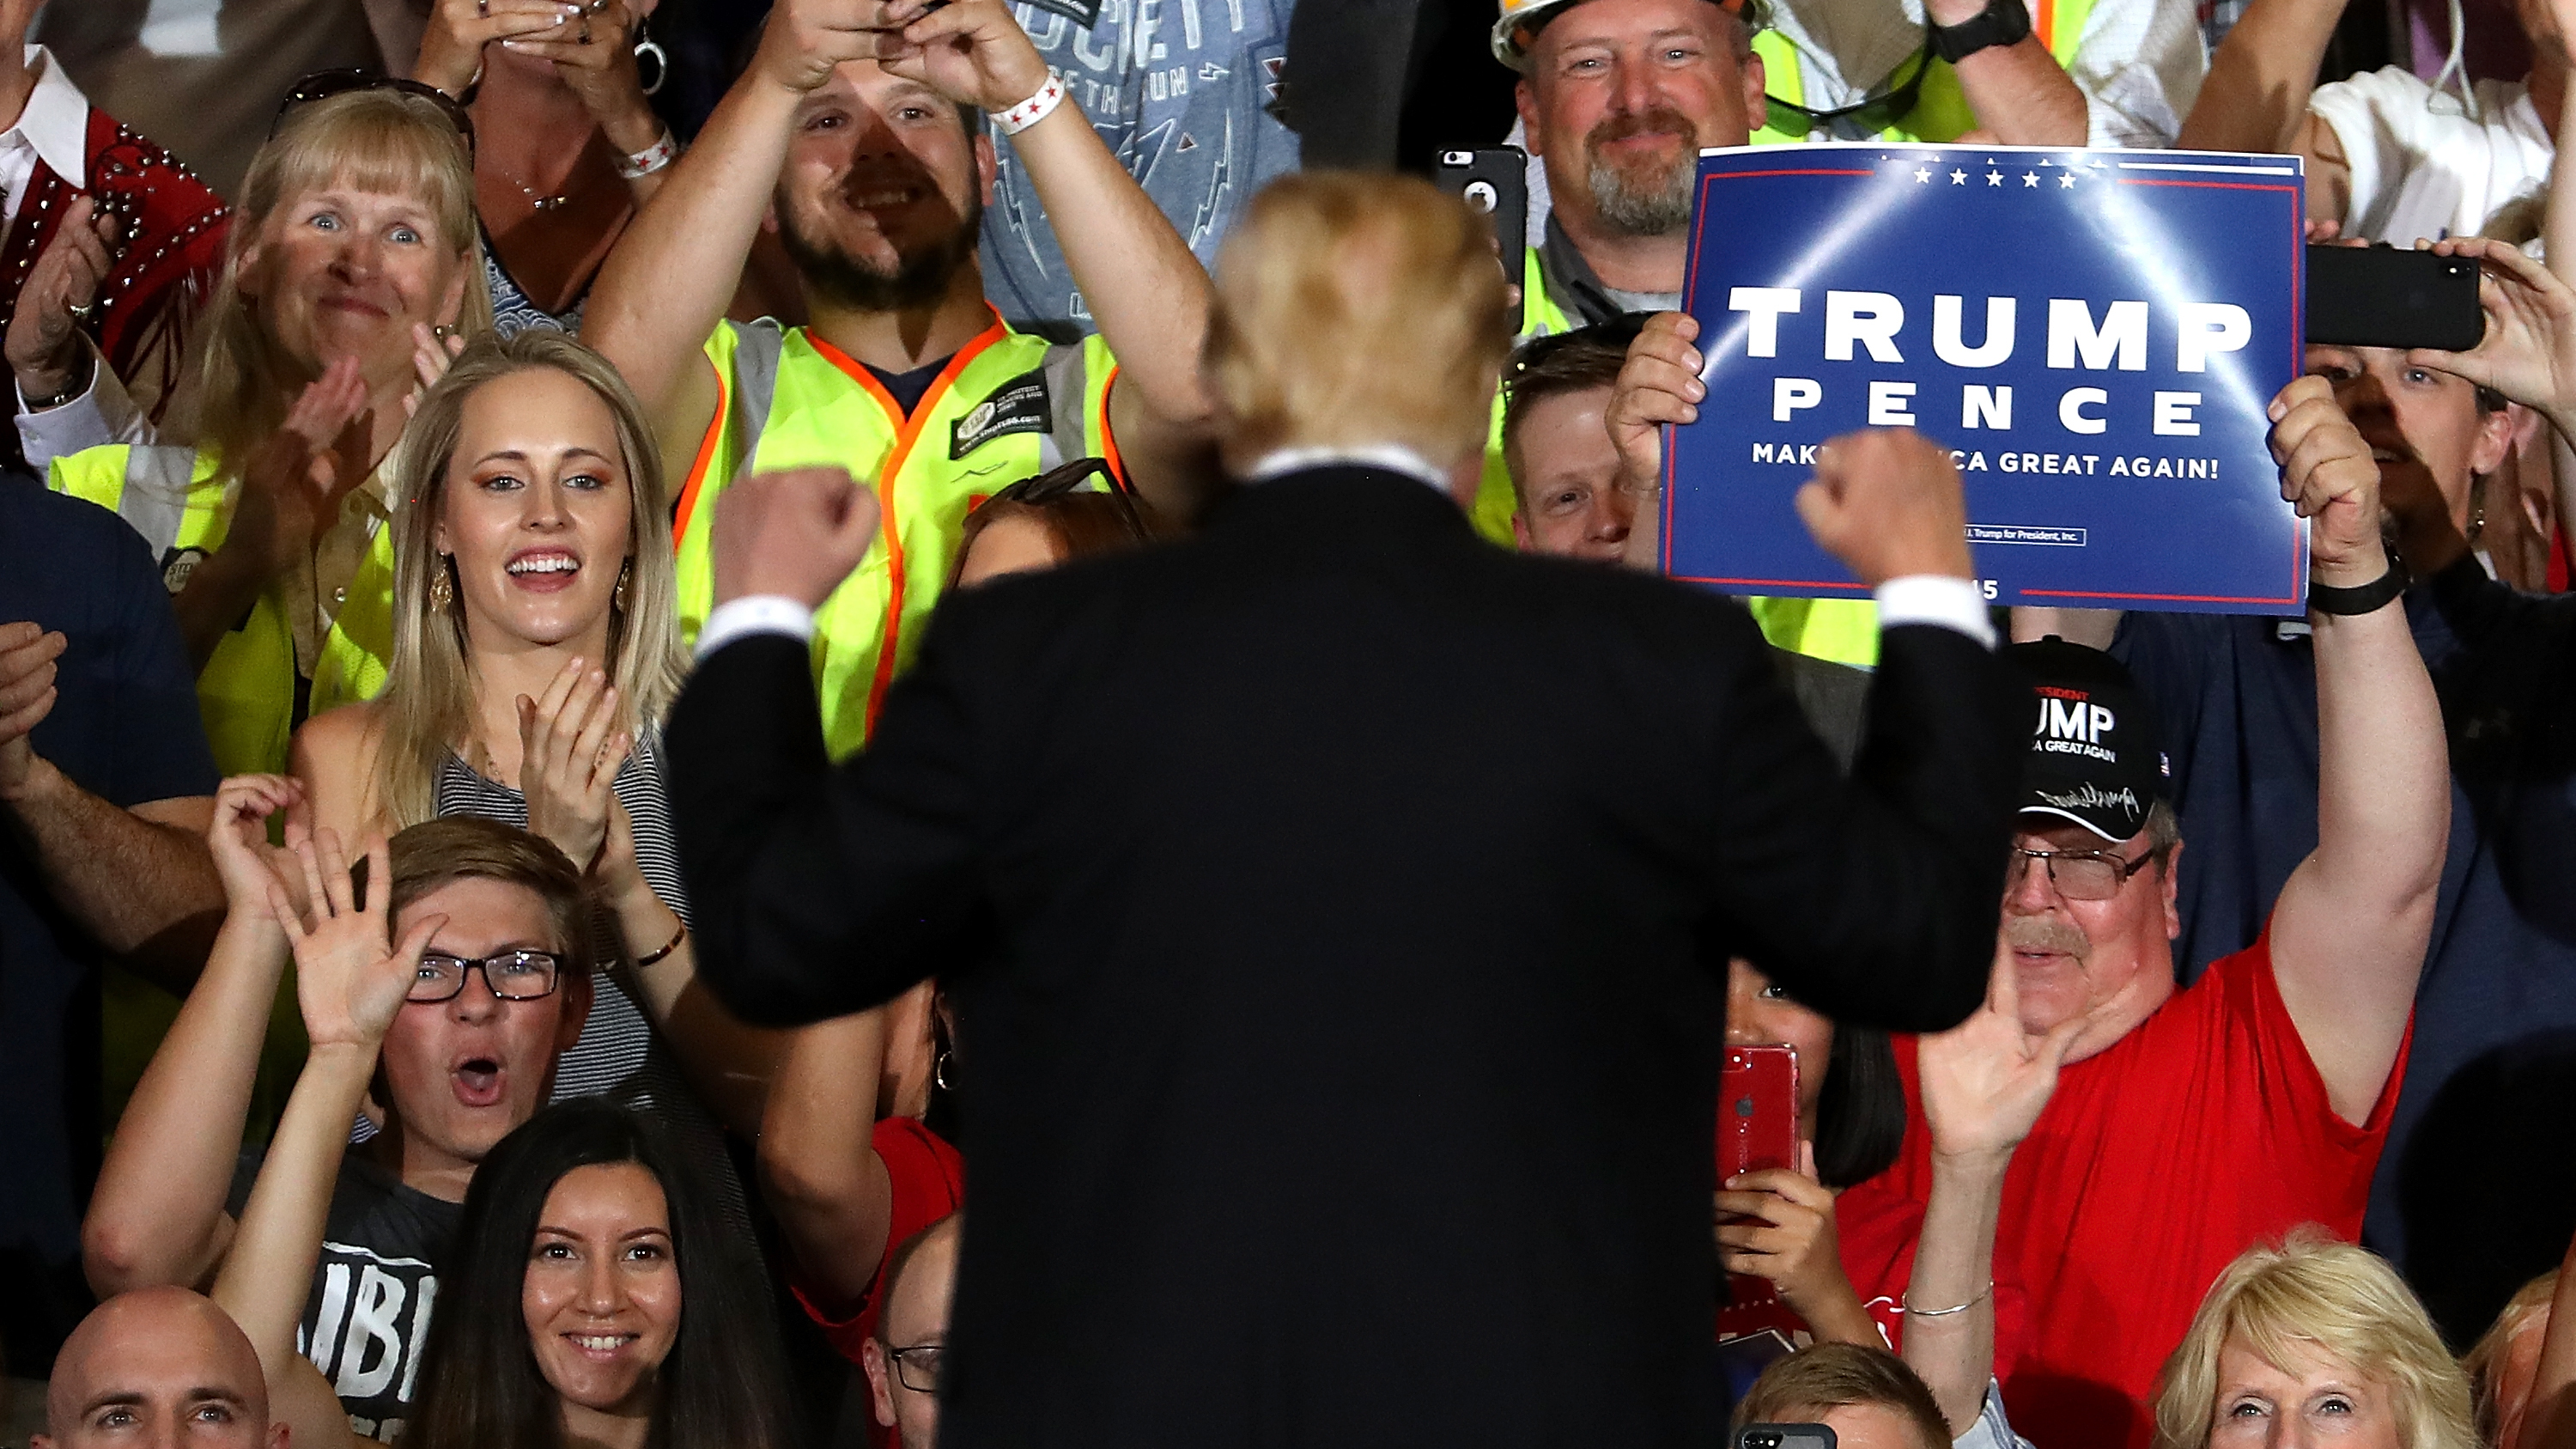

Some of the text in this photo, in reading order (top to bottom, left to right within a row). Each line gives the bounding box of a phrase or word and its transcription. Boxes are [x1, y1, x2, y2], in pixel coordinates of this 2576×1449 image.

[1148, 66, 1188, 101] UN
[1728, 286, 2253, 373] TRUMP
[1772, 377, 2202, 436] PENCE
[1752, 442, 1822, 465] MAK
[1998, 452, 2100, 476] GREAT
[2109, 456, 2219, 479] AGAIN!
[1974, 528, 2003, 540] Trump
[2004, 529, 2017, 539] for
[2018, 530, 2061, 542] President,
[2062, 532, 2078, 541] Inc.
[2044, 740, 2084, 754] GREAT
[2083, 744, 2117, 763] AGAIN
